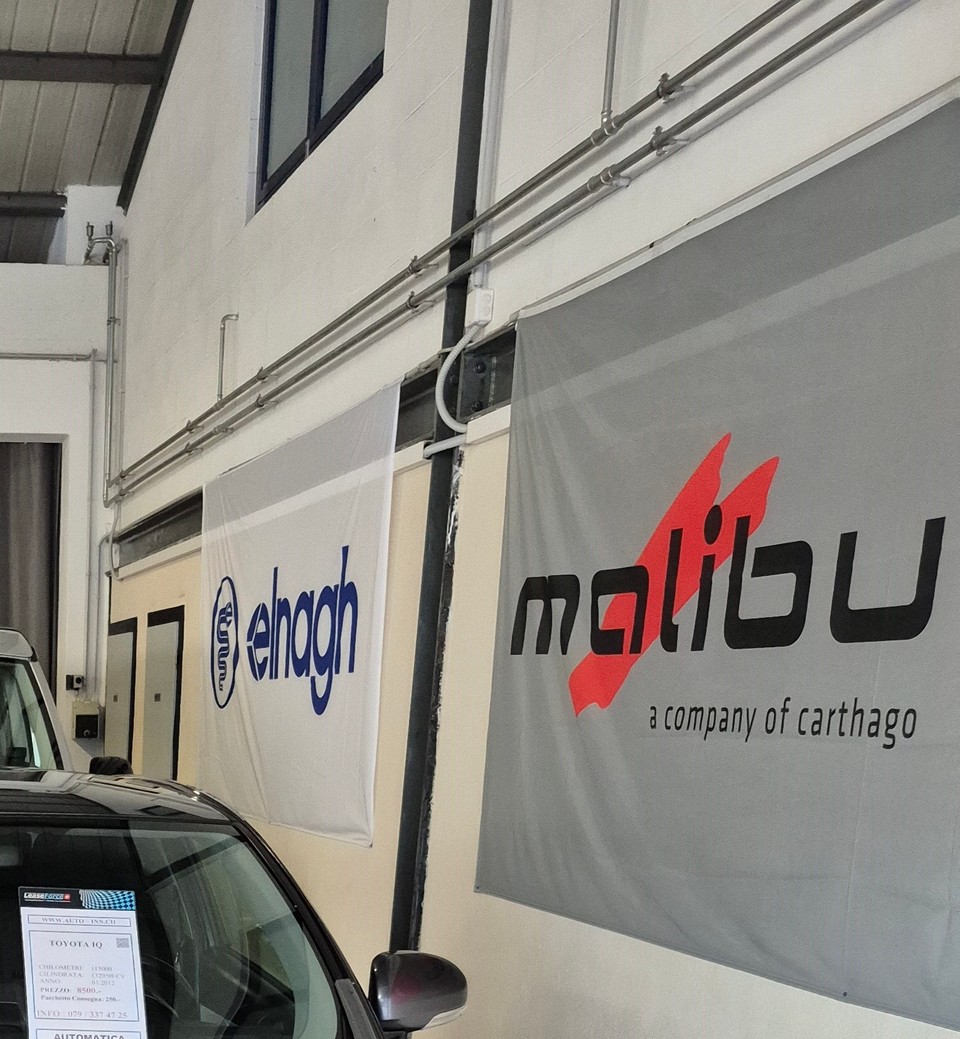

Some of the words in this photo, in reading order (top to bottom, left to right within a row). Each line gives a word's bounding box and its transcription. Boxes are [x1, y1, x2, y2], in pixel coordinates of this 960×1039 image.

[510, 504, 946, 655] malibu
[246, 545, 358, 716] elnagh
[649, 705, 657, 729] a
[664, 705, 757, 743] company
[765, 697, 791, 735] of
[797, 697, 917, 750] carthago
[49, 940, 89, 948] TOYOTA
[92, 941, 103, 949] IQ
[67, 1010, 82, 1018] 079
